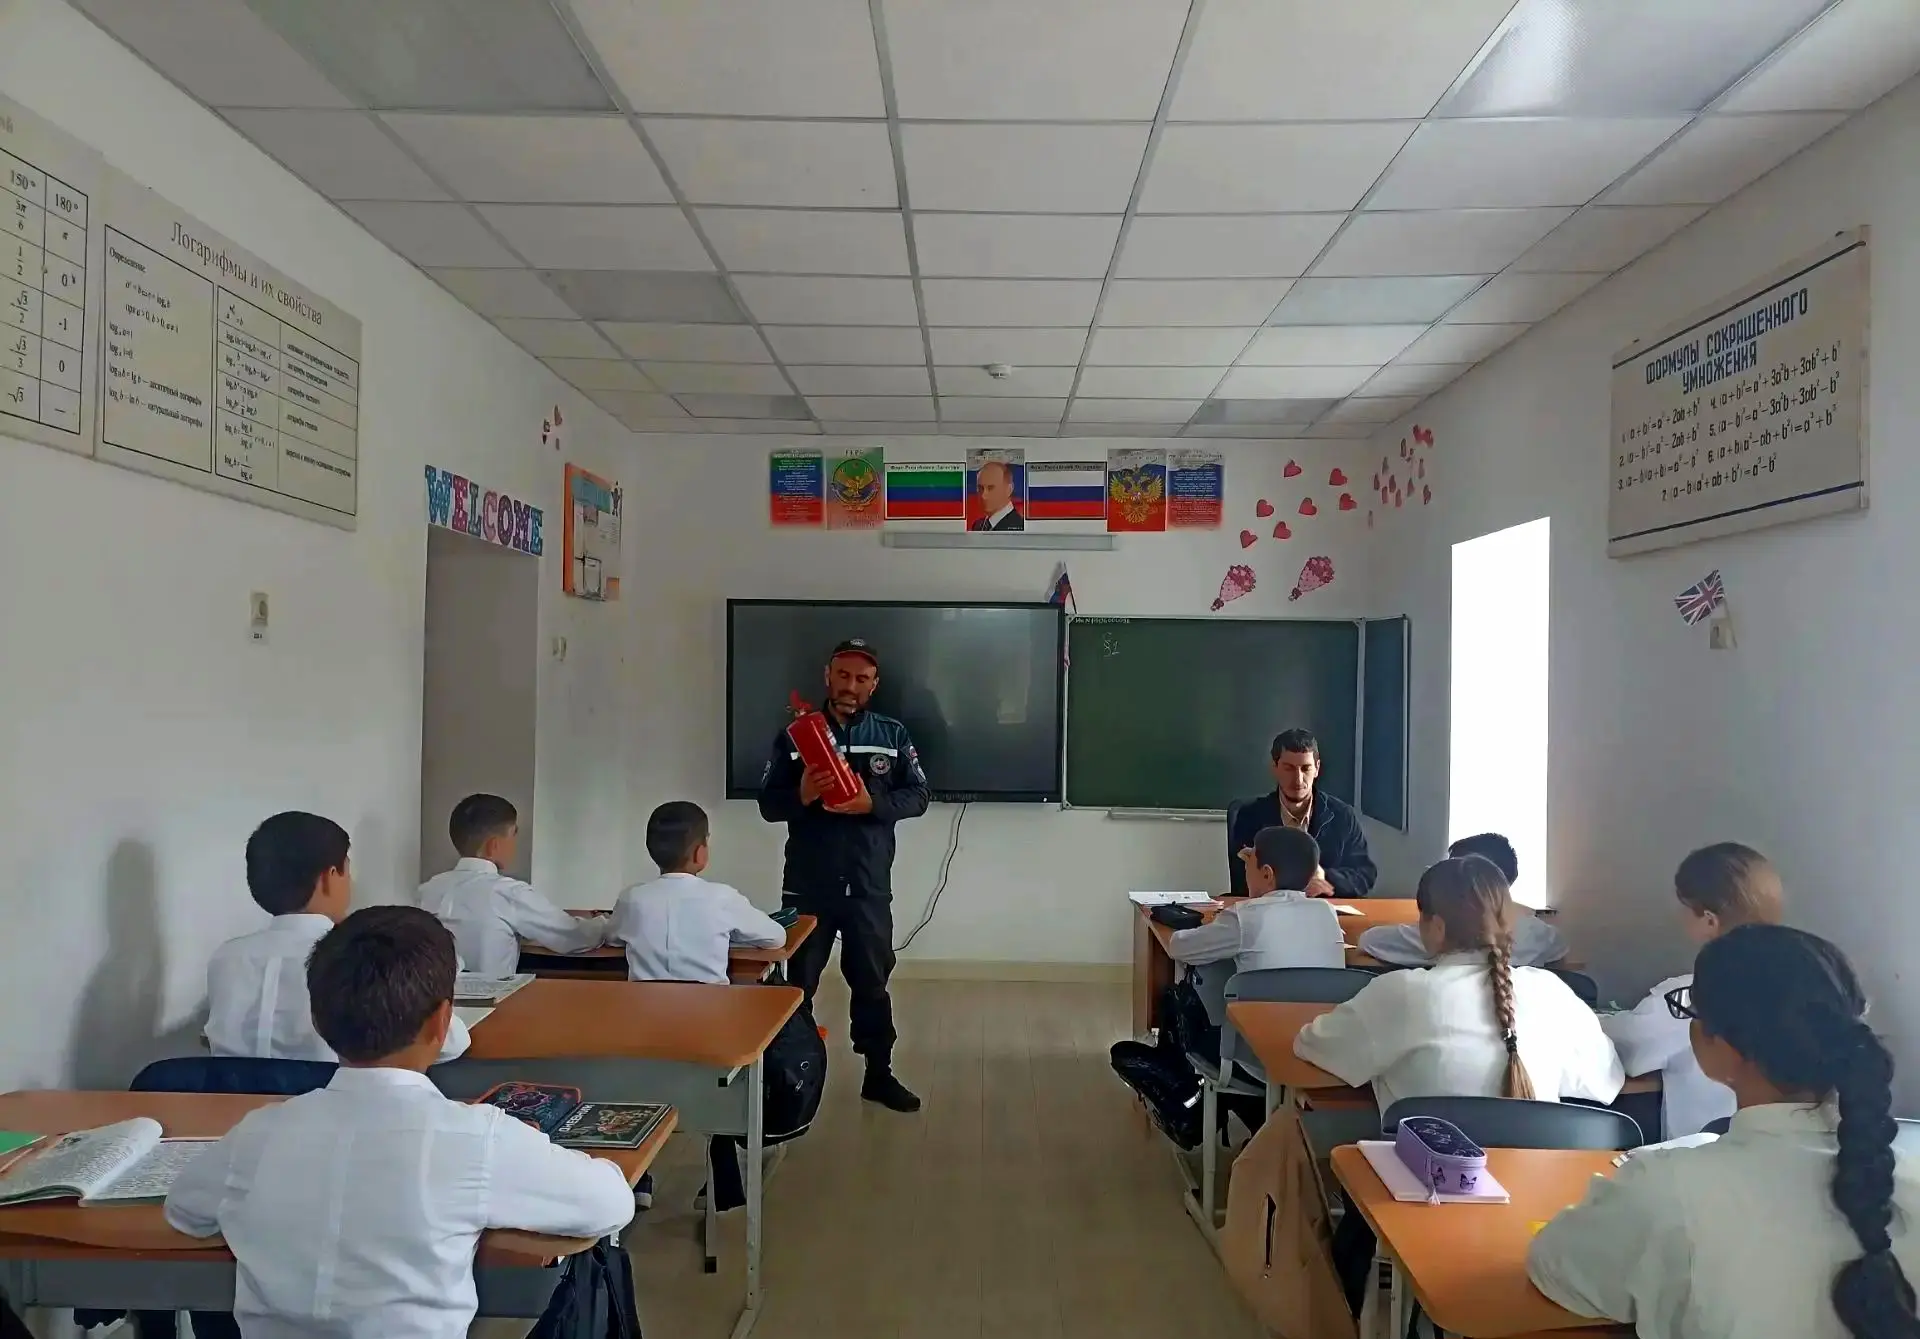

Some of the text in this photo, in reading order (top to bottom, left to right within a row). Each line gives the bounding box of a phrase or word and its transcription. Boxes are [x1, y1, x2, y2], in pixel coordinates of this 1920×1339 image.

[171, 221, 247, 283] Логарифмы
[250, 273, 257, 288] и
[261, 278, 274, 299] их
[277, 287, 322, 325] свойства
[1646, 287, 1808, 384] ФОРМУЛЫ СОКРАЩЕННОГО
[1683, 341, 1757, 394] УМНОЖЕНИЯ
[424, 464, 544, 557] WELCOME
